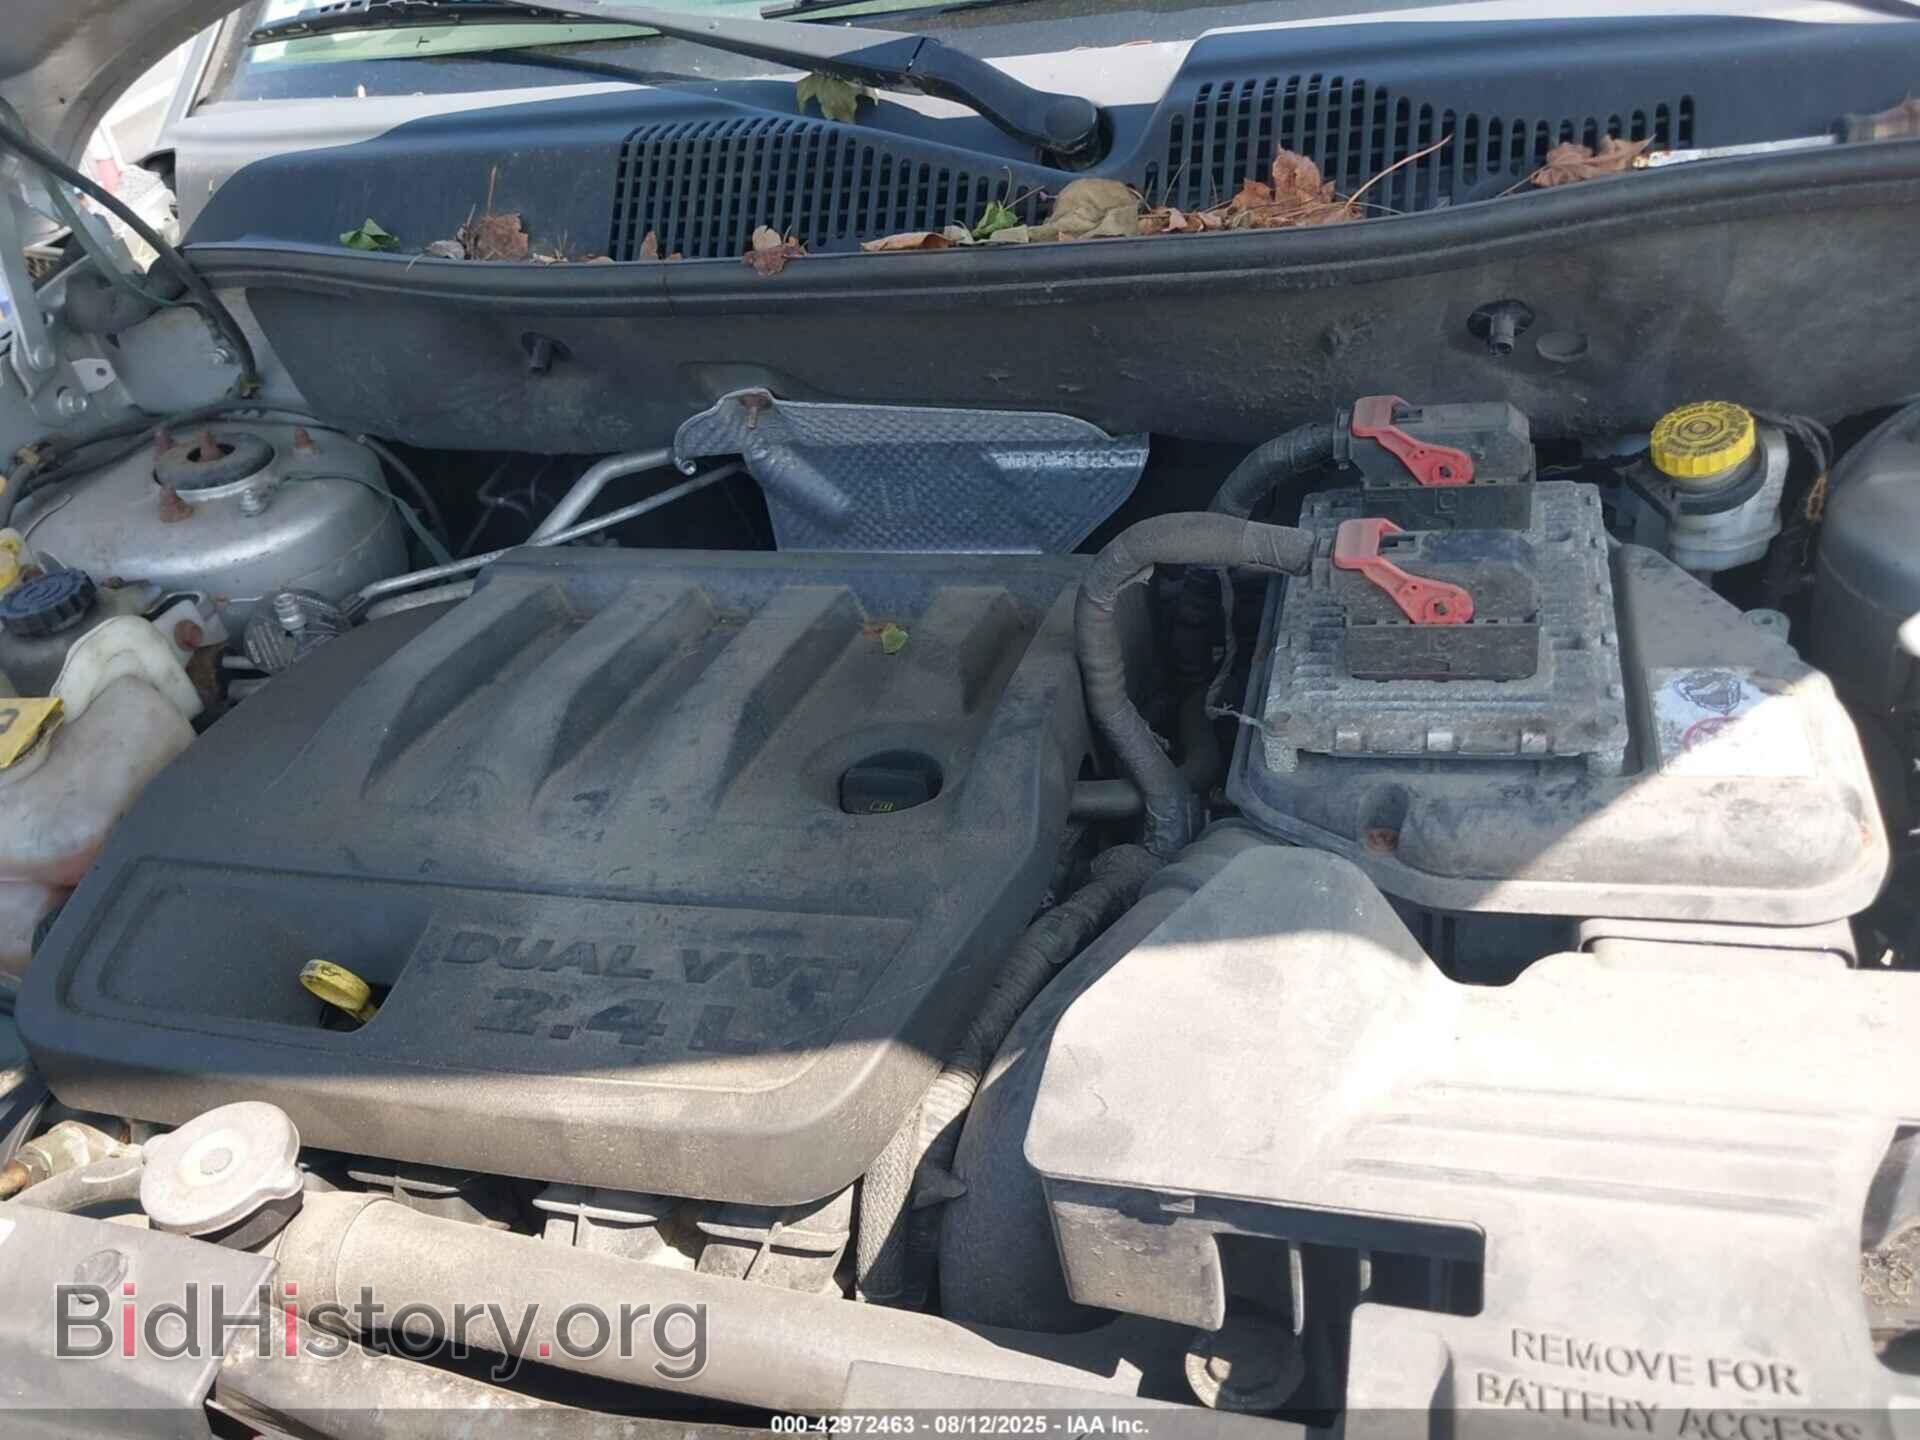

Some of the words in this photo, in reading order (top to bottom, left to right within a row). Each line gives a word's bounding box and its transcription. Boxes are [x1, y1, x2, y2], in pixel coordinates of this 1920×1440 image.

[442, 931, 654, 979] DUAL
[474, 987, 758, 1055] 2.4L
[1511, 1328, 1694, 1386] REMOVE
[1708, 1357, 1803, 1396] FOR
[1476, 1372, 1659, 1432] BATTERY
